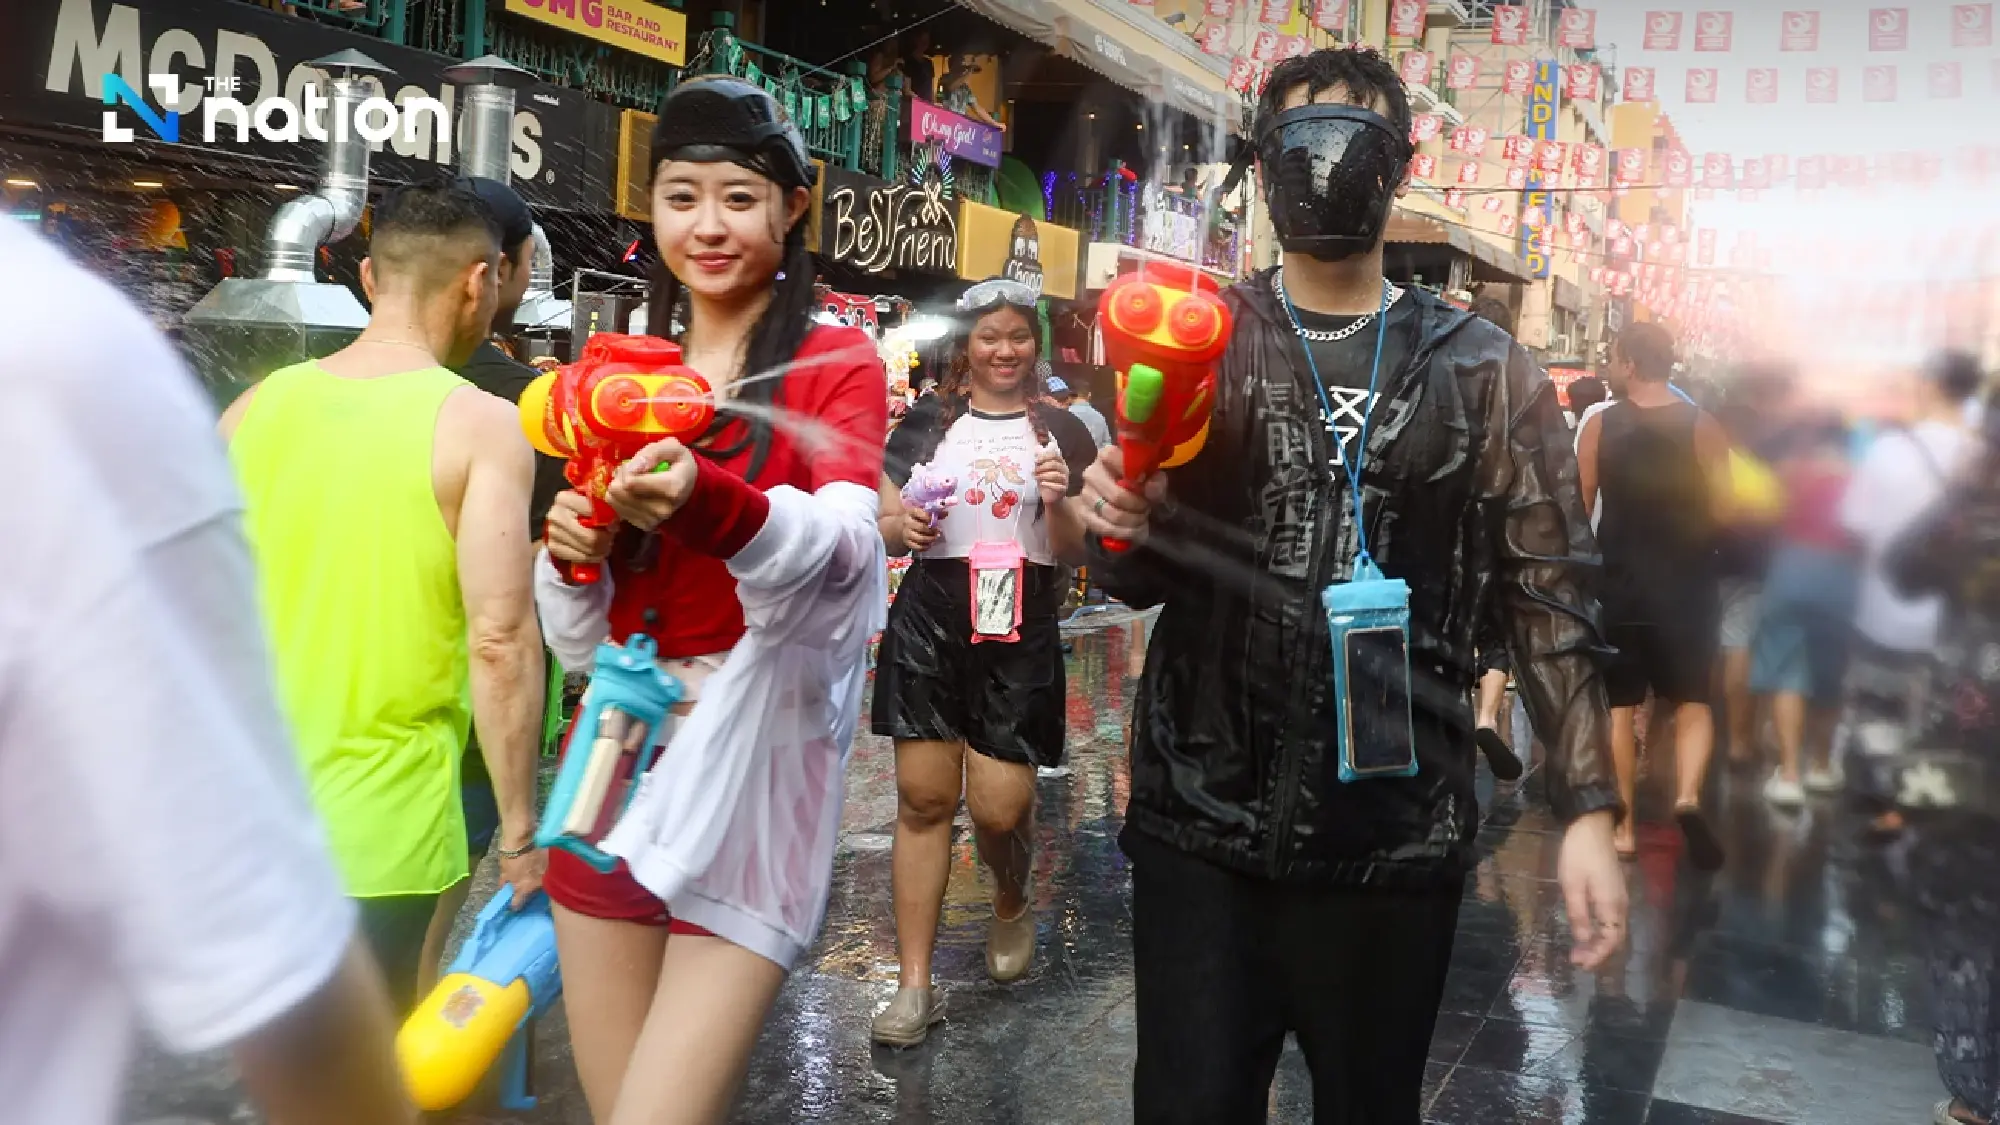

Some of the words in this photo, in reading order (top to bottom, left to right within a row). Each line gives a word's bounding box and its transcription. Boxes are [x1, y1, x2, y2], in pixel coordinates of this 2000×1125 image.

[524, 0, 603, 28] MG
[607, 5, 632, 22] BAR
[636, 17, 661, 32] AND
[606, 19, 679, 52] RESTAURANT
